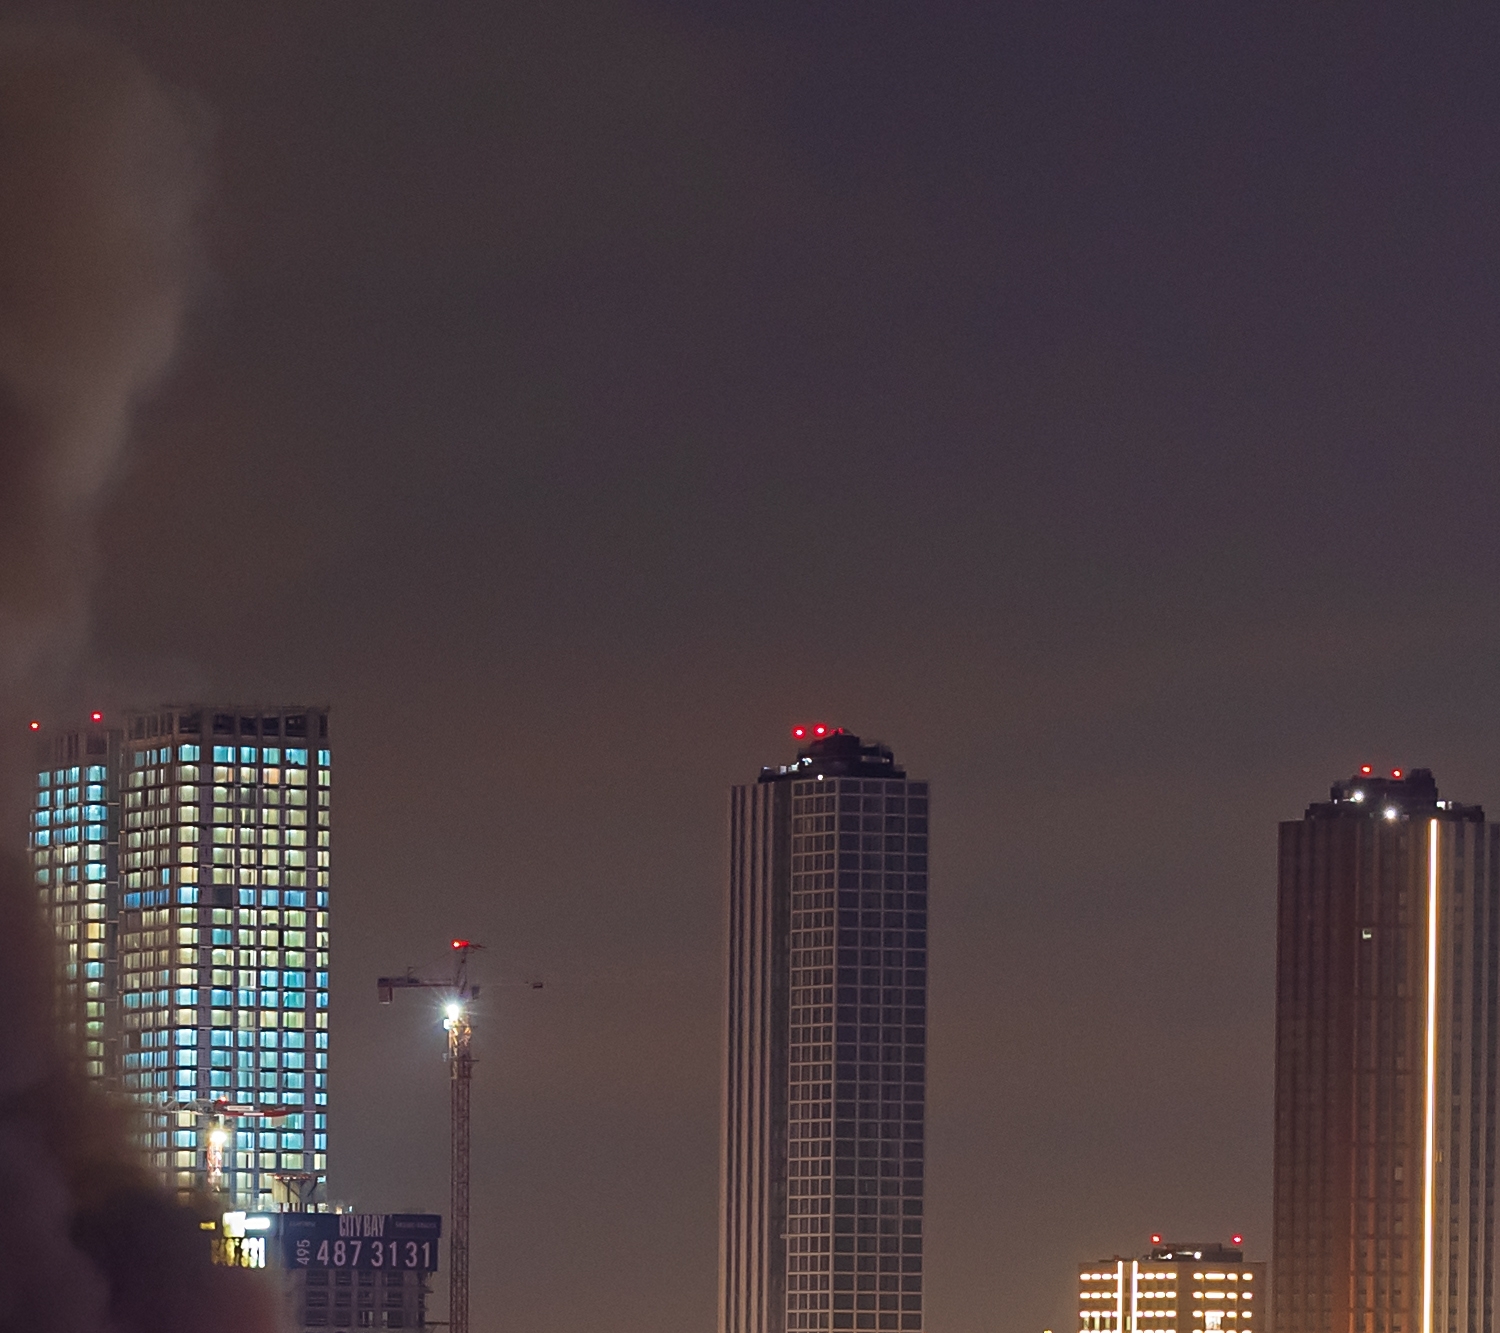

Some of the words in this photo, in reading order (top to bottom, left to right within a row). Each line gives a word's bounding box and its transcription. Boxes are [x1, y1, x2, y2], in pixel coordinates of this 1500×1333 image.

[339, 1214, 362, 1237] CITY
[363, 1214, 385, 1237] BAY
[296, 1238, 311, 1266] 495
